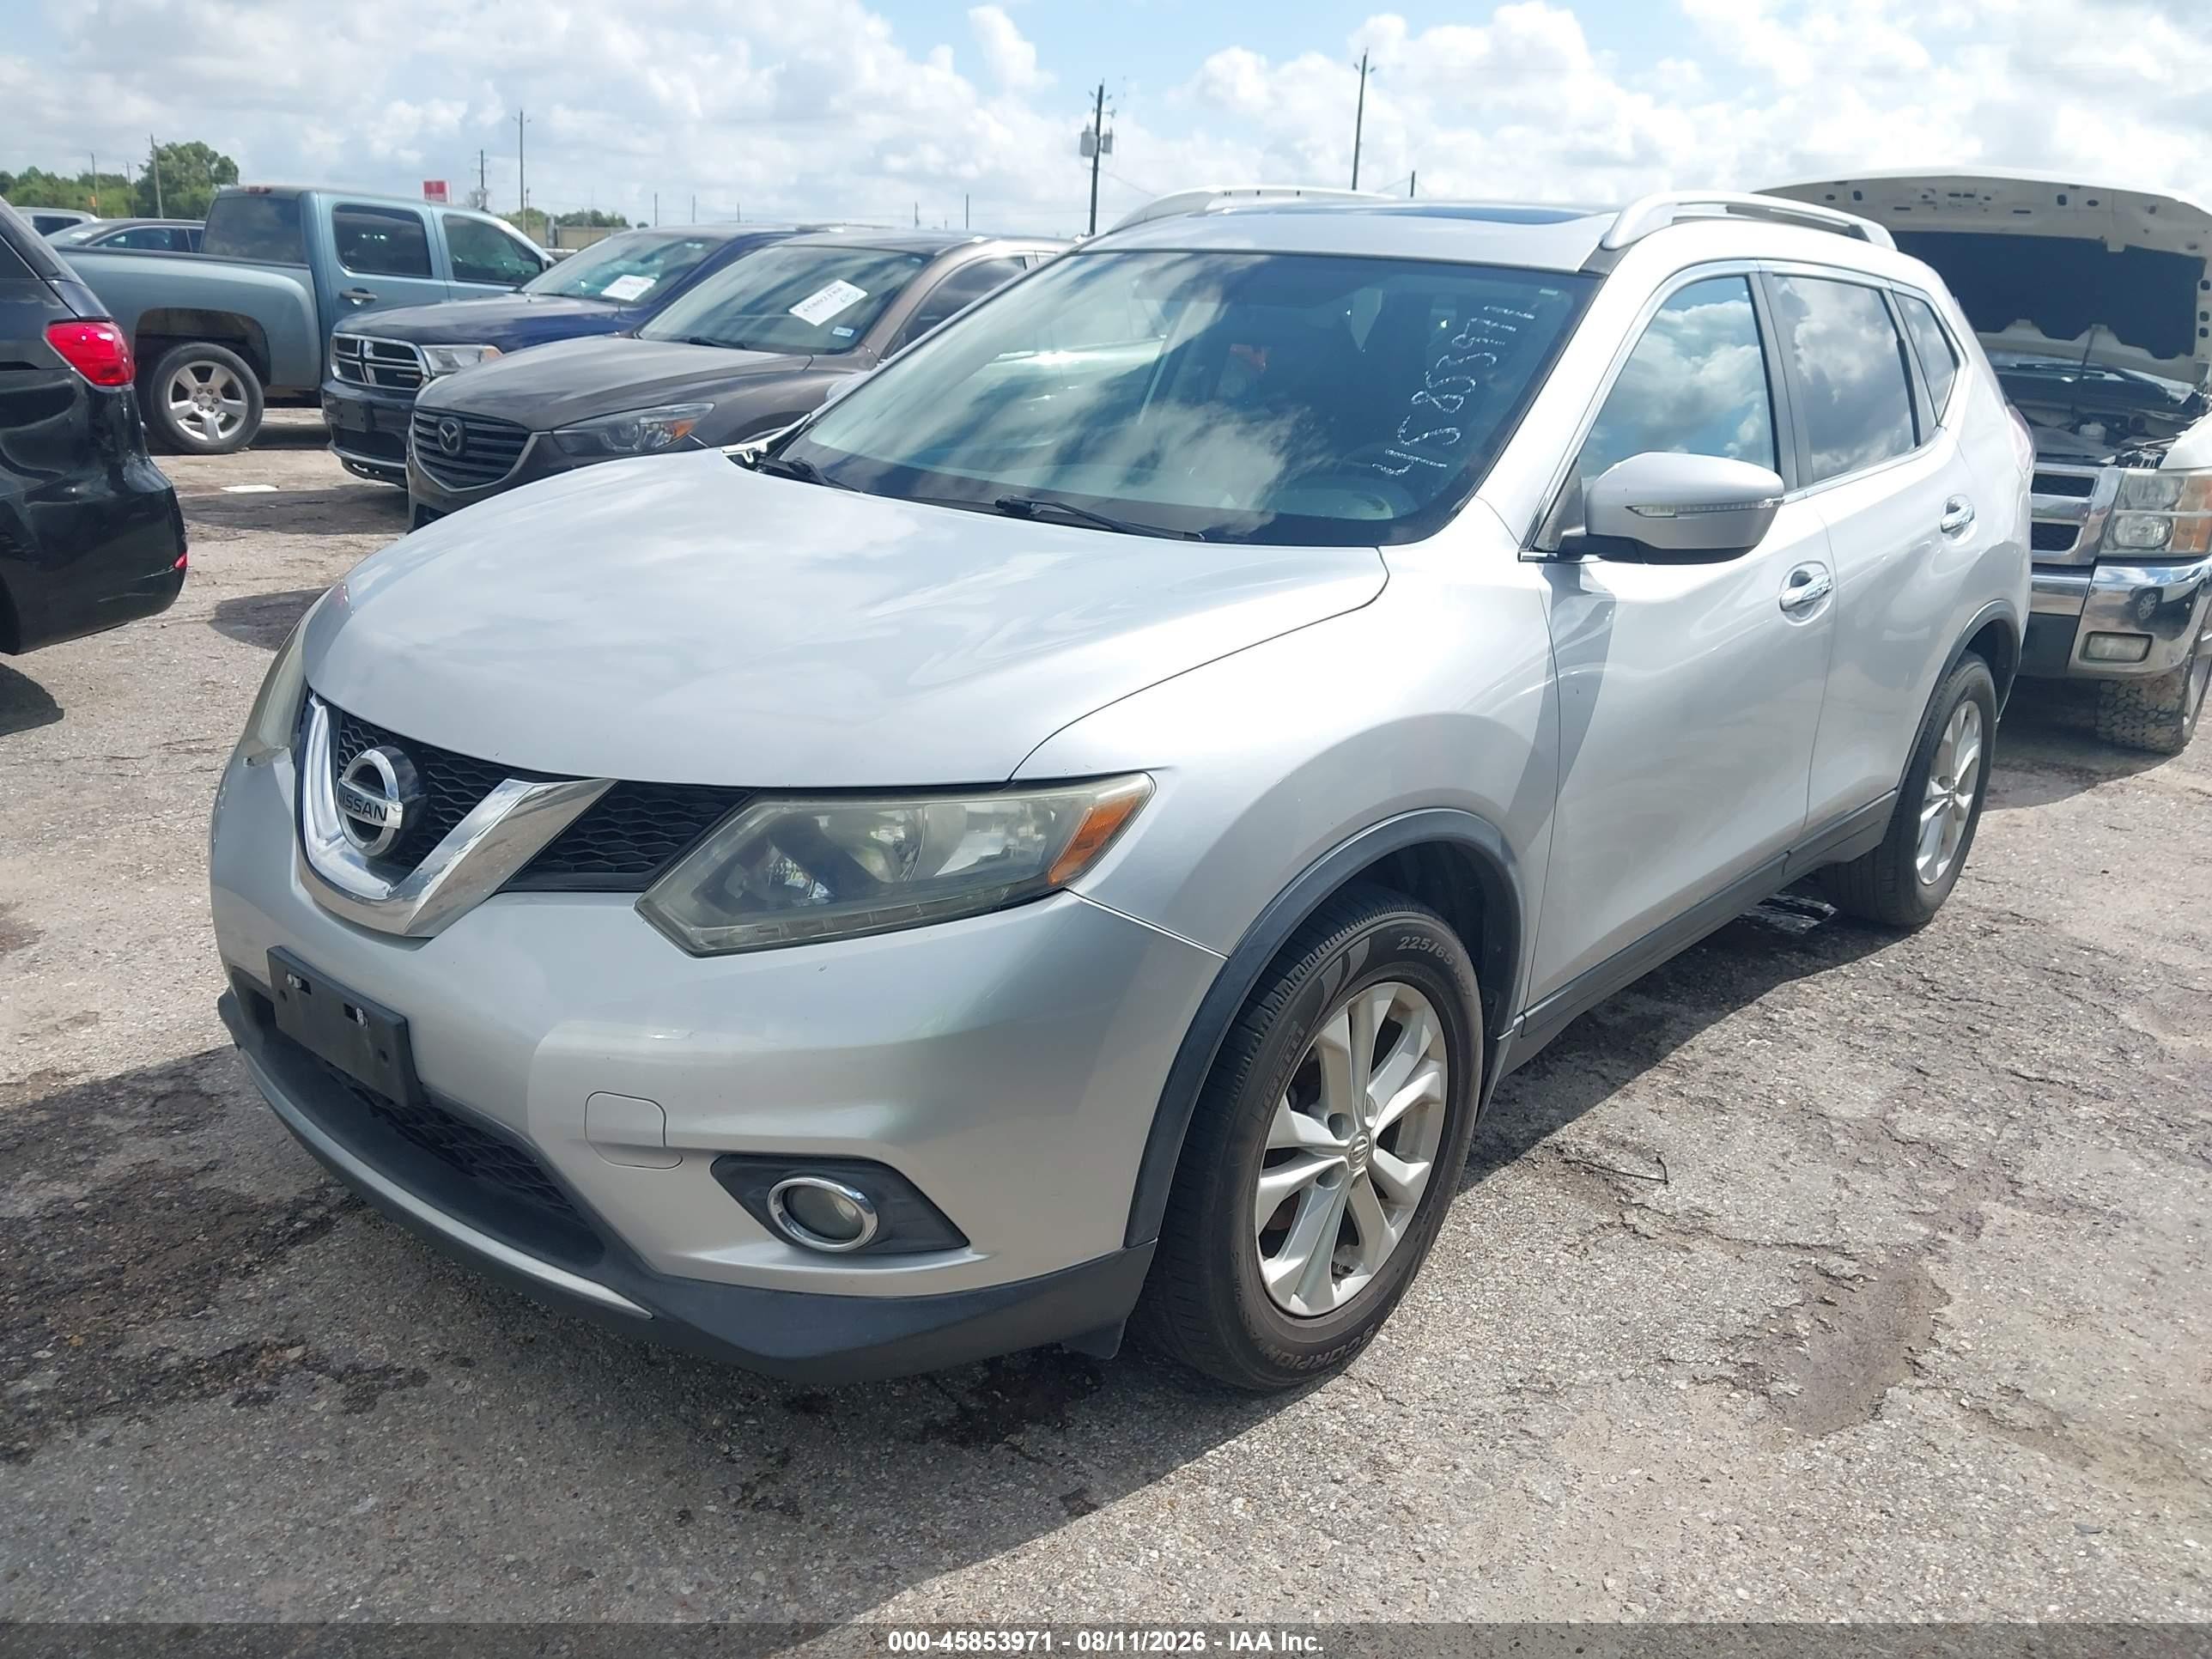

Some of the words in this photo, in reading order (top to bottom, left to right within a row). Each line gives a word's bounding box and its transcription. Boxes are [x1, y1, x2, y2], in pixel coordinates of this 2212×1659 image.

[1371, 304, 1535, 476] 45853971
[338, 786, 388, 822] NISSAN
[1396, 935, 1455, 965] 225/65
